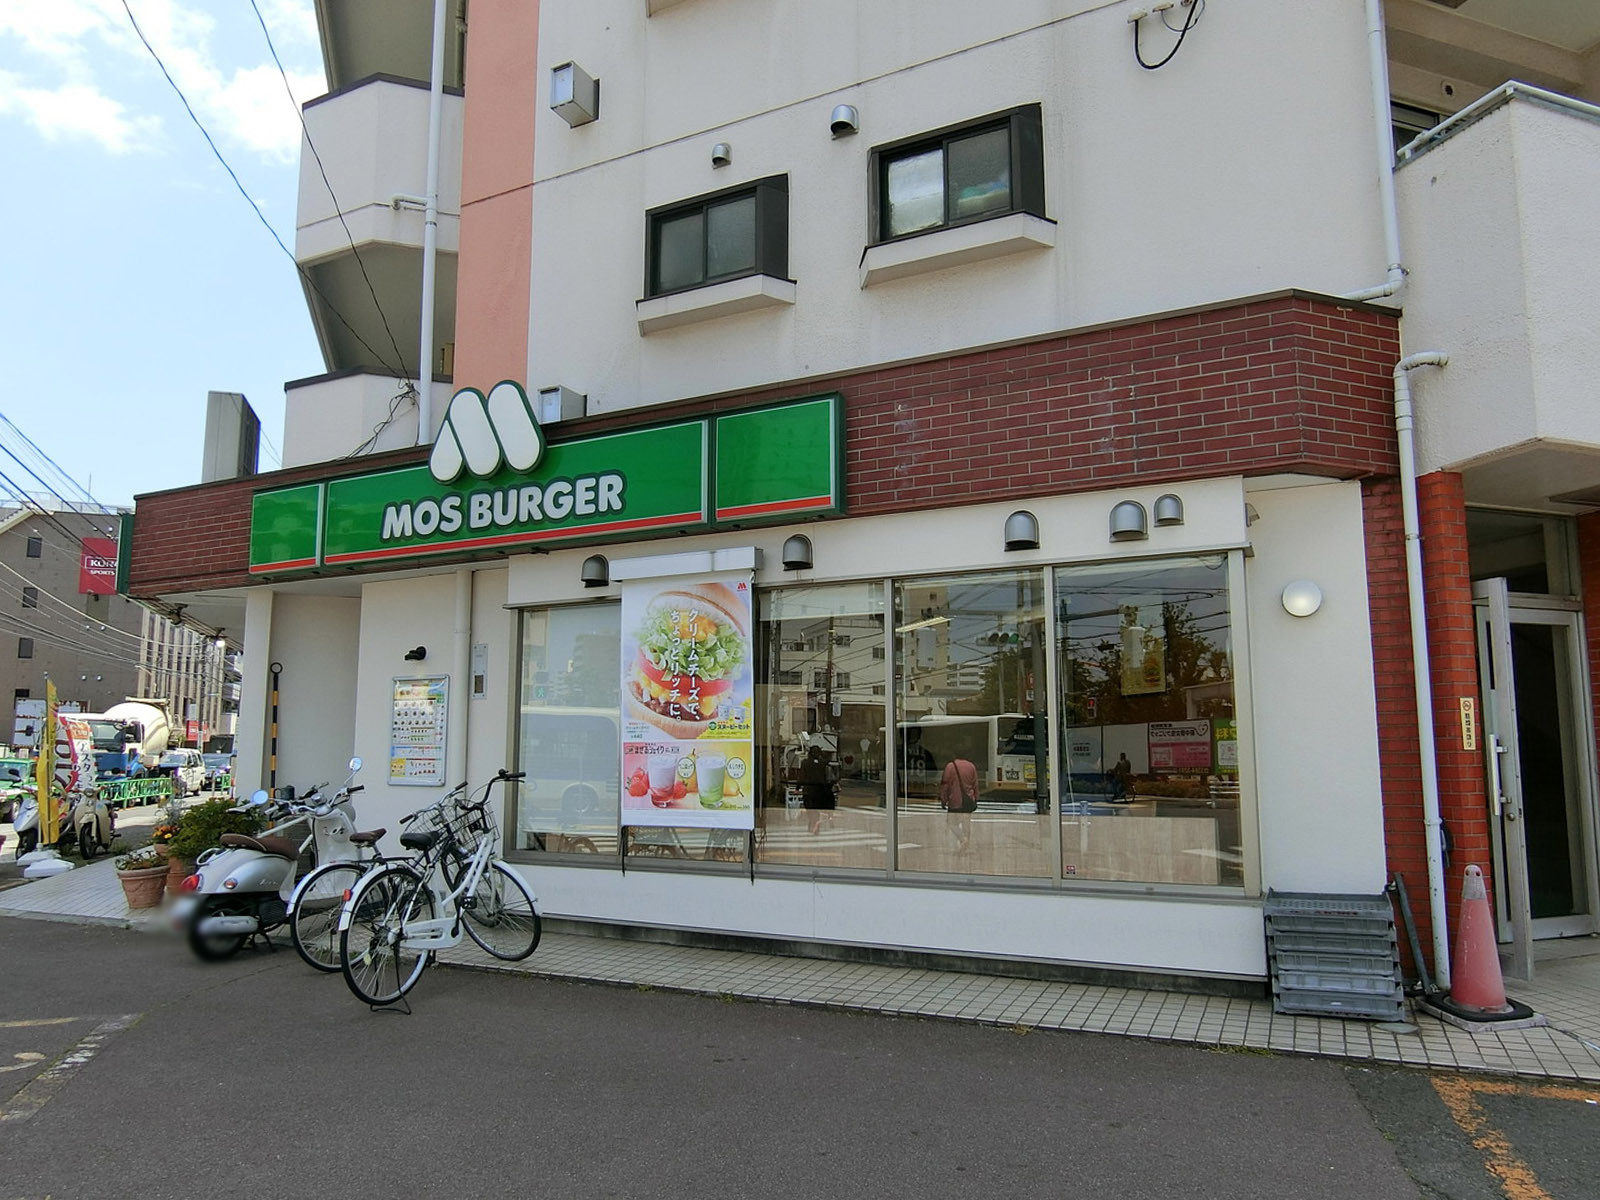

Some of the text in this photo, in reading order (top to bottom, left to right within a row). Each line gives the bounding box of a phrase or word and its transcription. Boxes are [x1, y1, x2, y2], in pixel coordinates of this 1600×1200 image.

[381, 473, 624, 540] MOS BURGER
[669, 610, 681, 722] ちょっとリッチに。
[687, 608, 701, 721] クリームチーズで、
